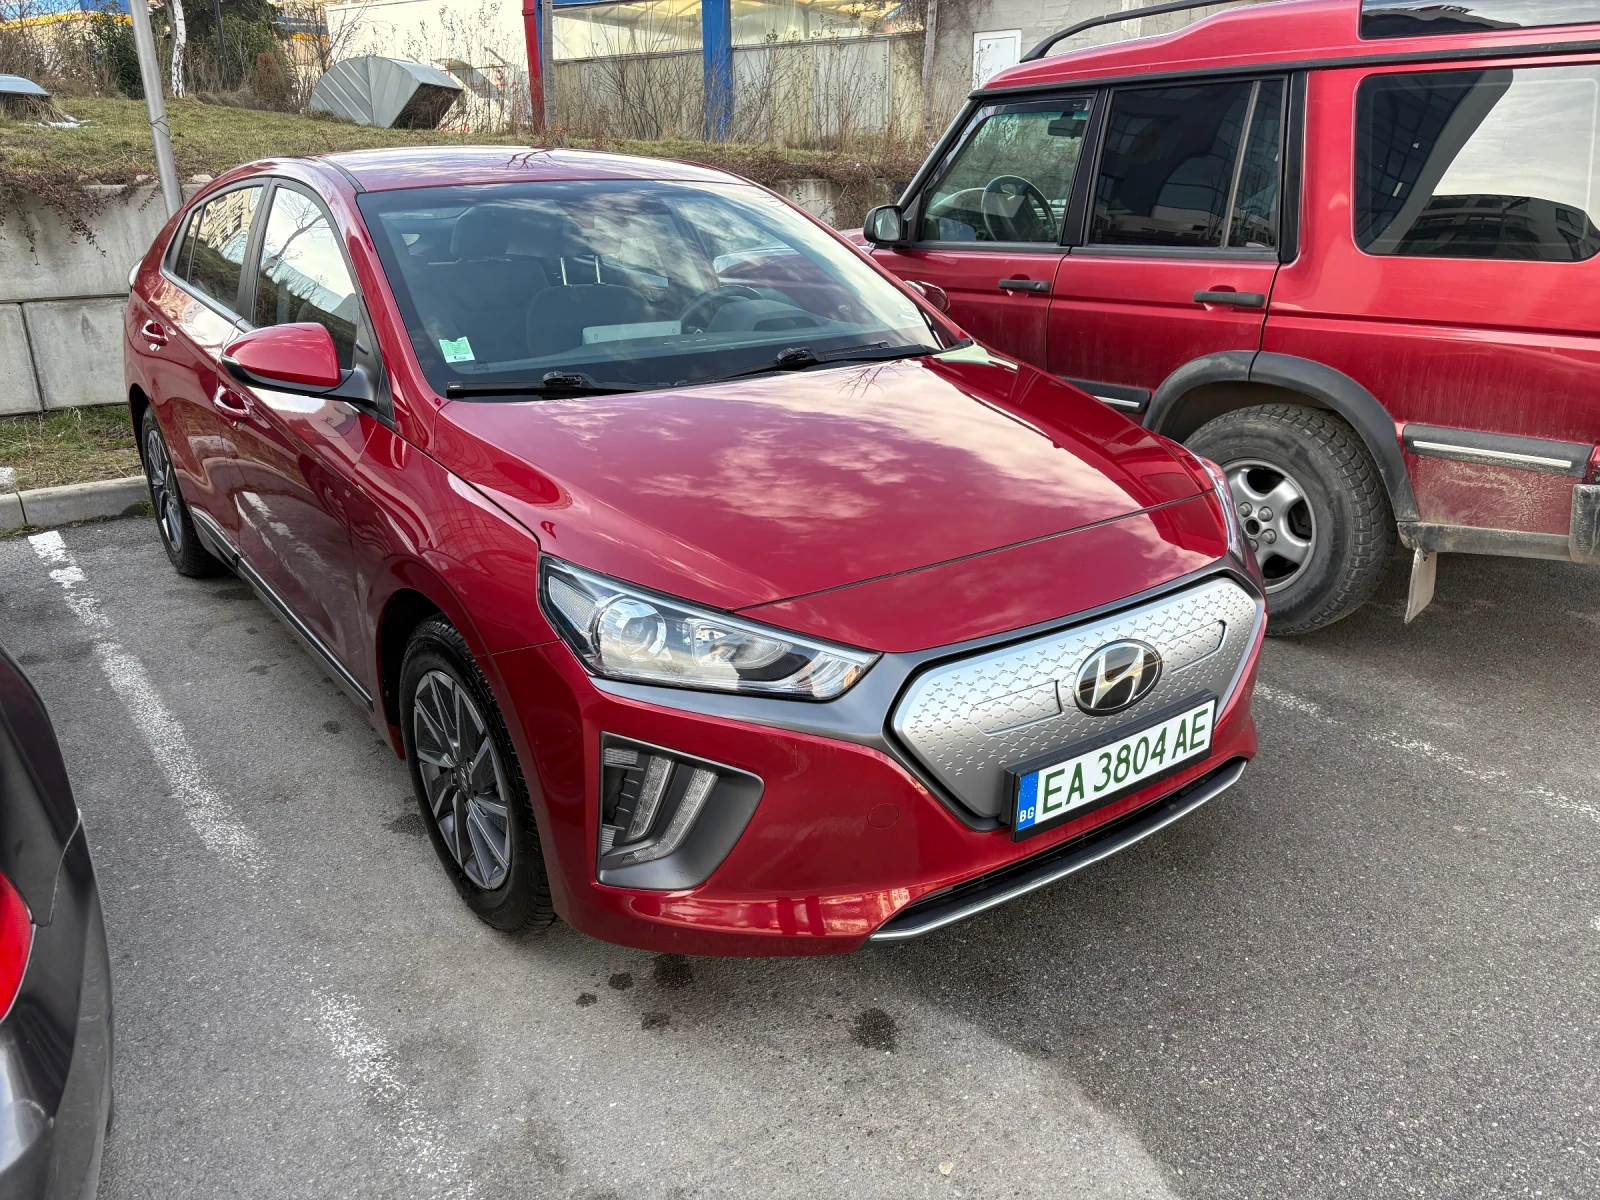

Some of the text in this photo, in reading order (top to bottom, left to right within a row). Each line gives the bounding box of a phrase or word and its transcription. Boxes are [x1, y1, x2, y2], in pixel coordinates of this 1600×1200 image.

[1042, 709, 1209, 814] EA 3804 AE
[1019, 807, 1034, 822] BG
